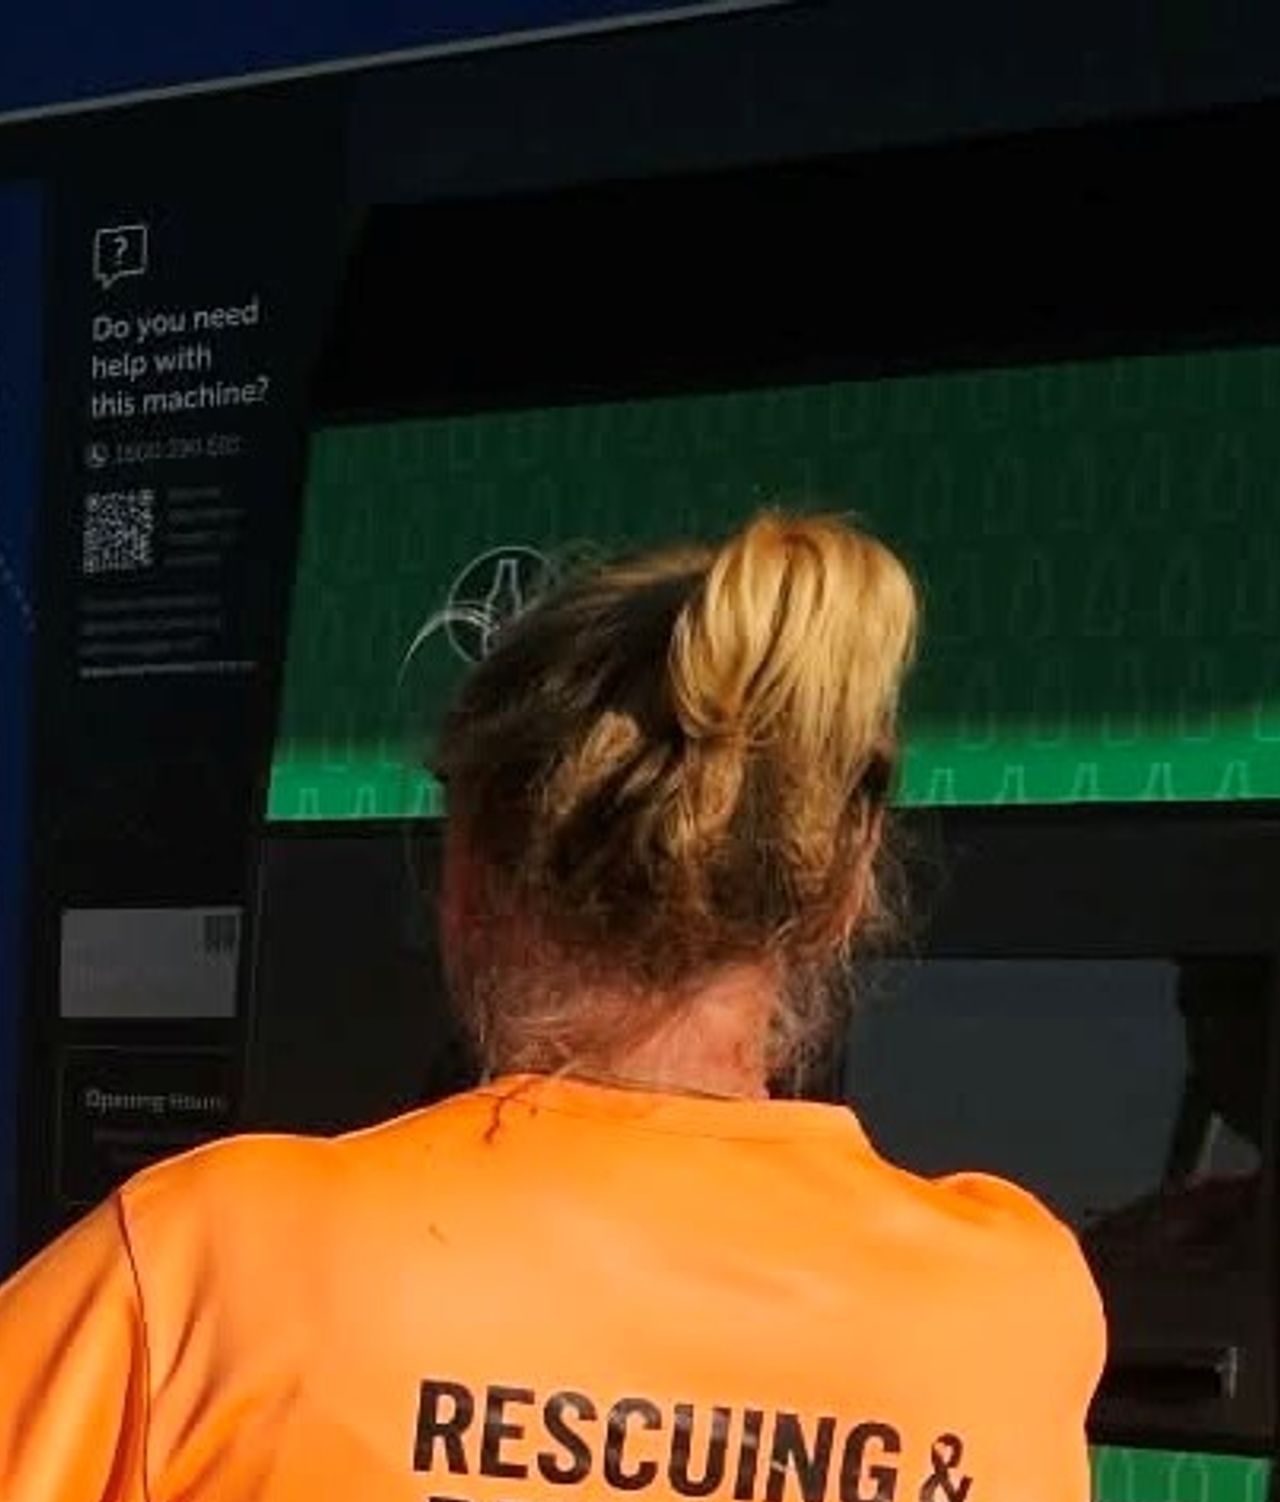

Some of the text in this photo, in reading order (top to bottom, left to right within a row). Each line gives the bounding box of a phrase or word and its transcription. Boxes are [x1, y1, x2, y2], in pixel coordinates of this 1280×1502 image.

[91, 293, 259, 344] Do you need
[91, 342, 212, 383] help with
[91, 374, 270, 419] this machine?
